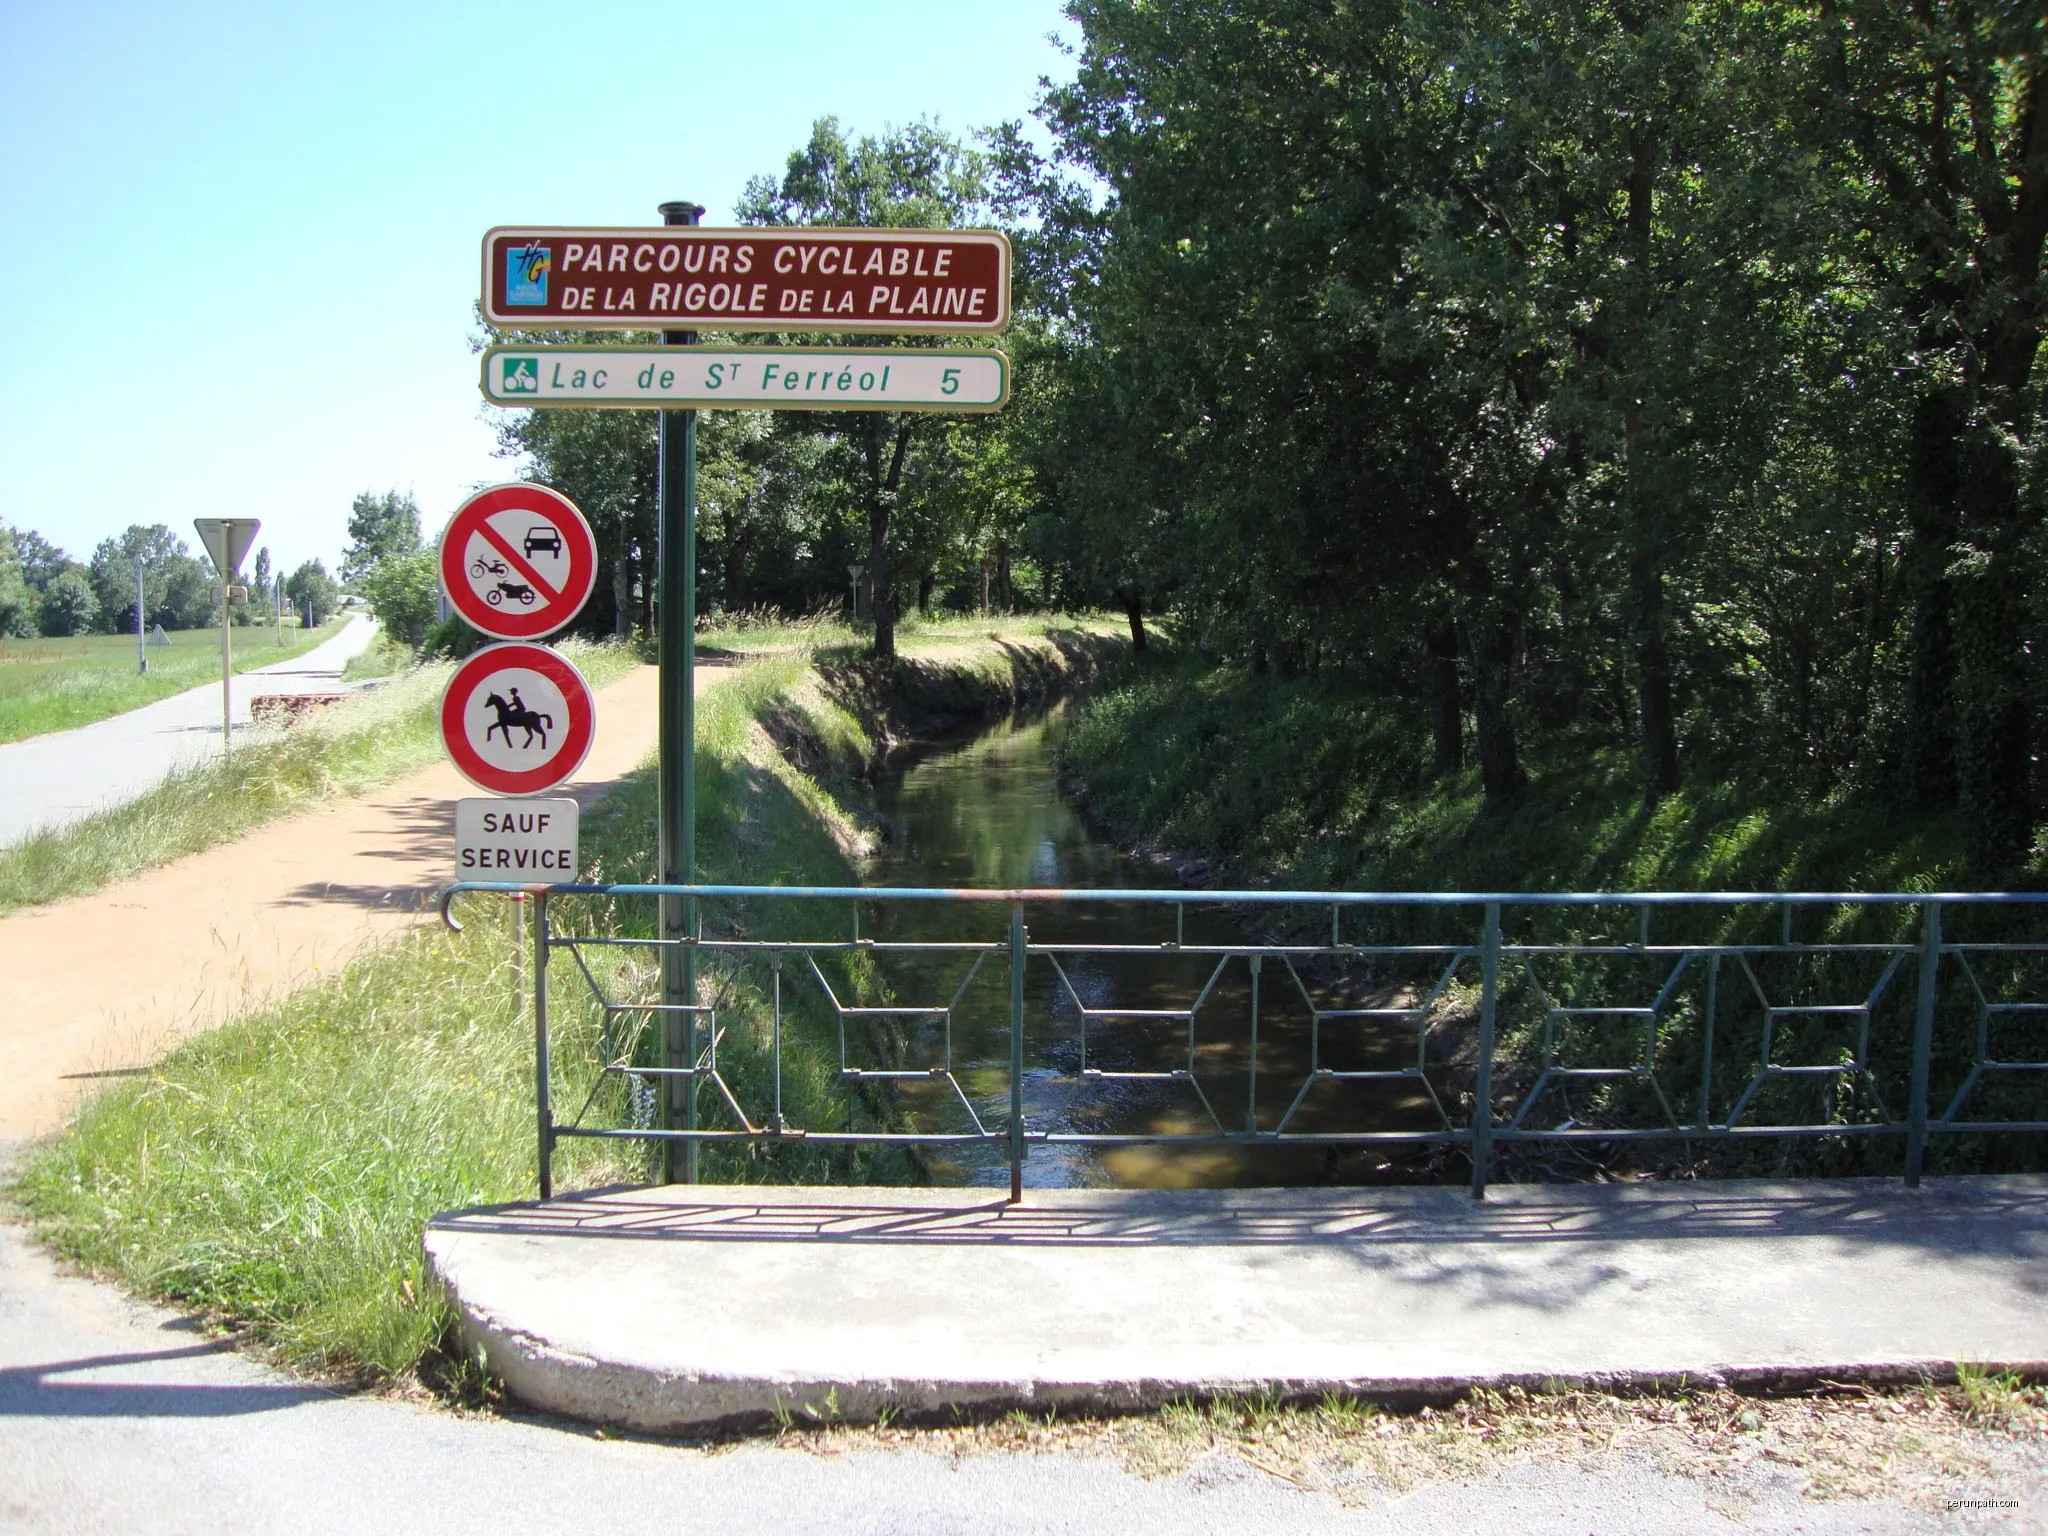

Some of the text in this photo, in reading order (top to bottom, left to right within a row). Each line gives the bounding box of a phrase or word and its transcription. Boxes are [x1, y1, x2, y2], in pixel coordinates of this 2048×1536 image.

[562, 243, 953, 277] PARCOURS CYCLABLE
[561, 282, 987, 316] DE LA RIGOLE DE LA PLAINE
[551, 362, 608, 389] Lac
[637, 363, 676, 389] de
[761, 363, 890, 392] Ferréol
[940, 368, 962, 395] 5
[483, 813, 551, 834] SAUF
[461, 848, 571, 870] SERVICE
